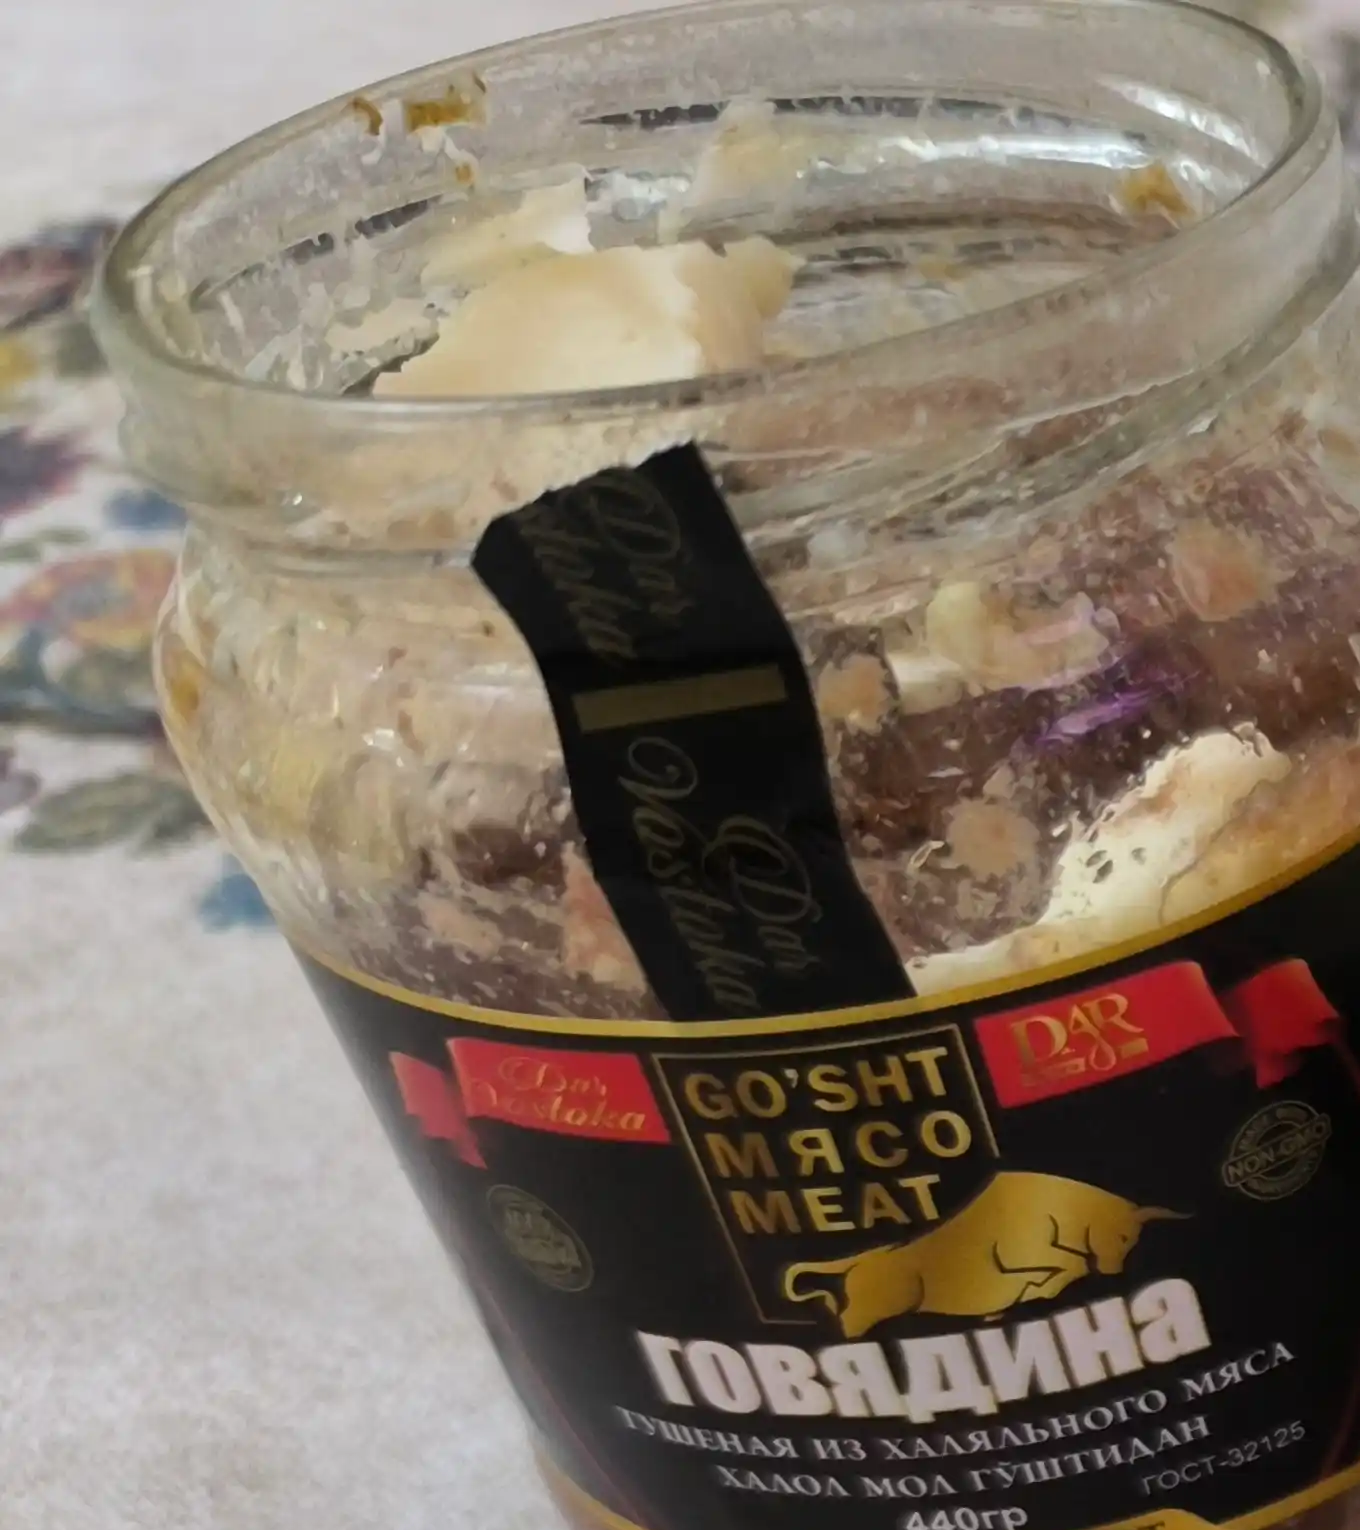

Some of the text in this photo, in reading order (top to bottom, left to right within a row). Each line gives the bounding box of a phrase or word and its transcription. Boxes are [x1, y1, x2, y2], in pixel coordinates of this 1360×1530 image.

[701, 815, 823, 978] Dar
[684, 1047, 948, 1120] GO'SHT
[704, 1110, 972, 1179] МЯСО
[729, 1174, 941, 1234] MEAT
[614, 1341, 1297, 1461] ТУШЕНАЯ ИЗ ХАЛЯЛЬНОГО МЯСА
[714, 1464, 850, 1498] ХАЛОЛ
[860, 1474, 957, 1498] МОЛ
[1140, 1420, 1307, 1497] ГОСТ-32125
